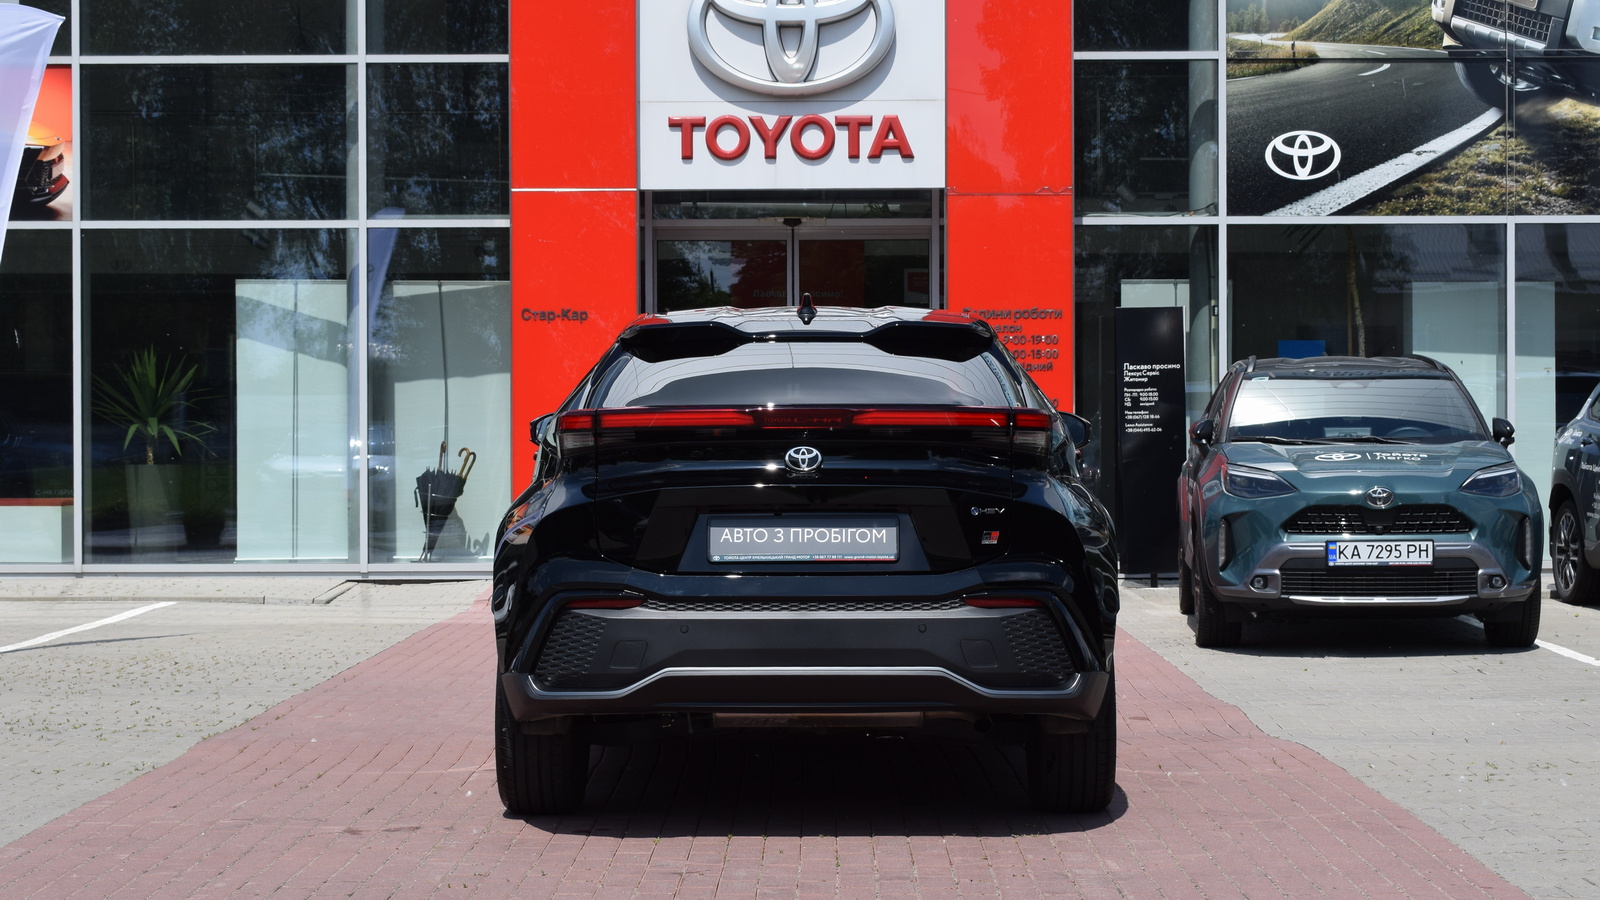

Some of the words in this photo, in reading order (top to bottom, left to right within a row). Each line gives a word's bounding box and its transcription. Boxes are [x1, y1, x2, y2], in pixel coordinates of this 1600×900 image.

[668, 114, 915, 161] TOYOTA
[521, 307, 588, 324] Стар-Кар
[1014, 306, 1063, 322] роботи
[994, 323, 1022, 334] алон
[720, 528, 768, 543] АВТО
[773, 528, 784, 543] З
[790, 528, 887, 543] ПРОБІГОМ
[1366, 544, 1402, 559] 7295
